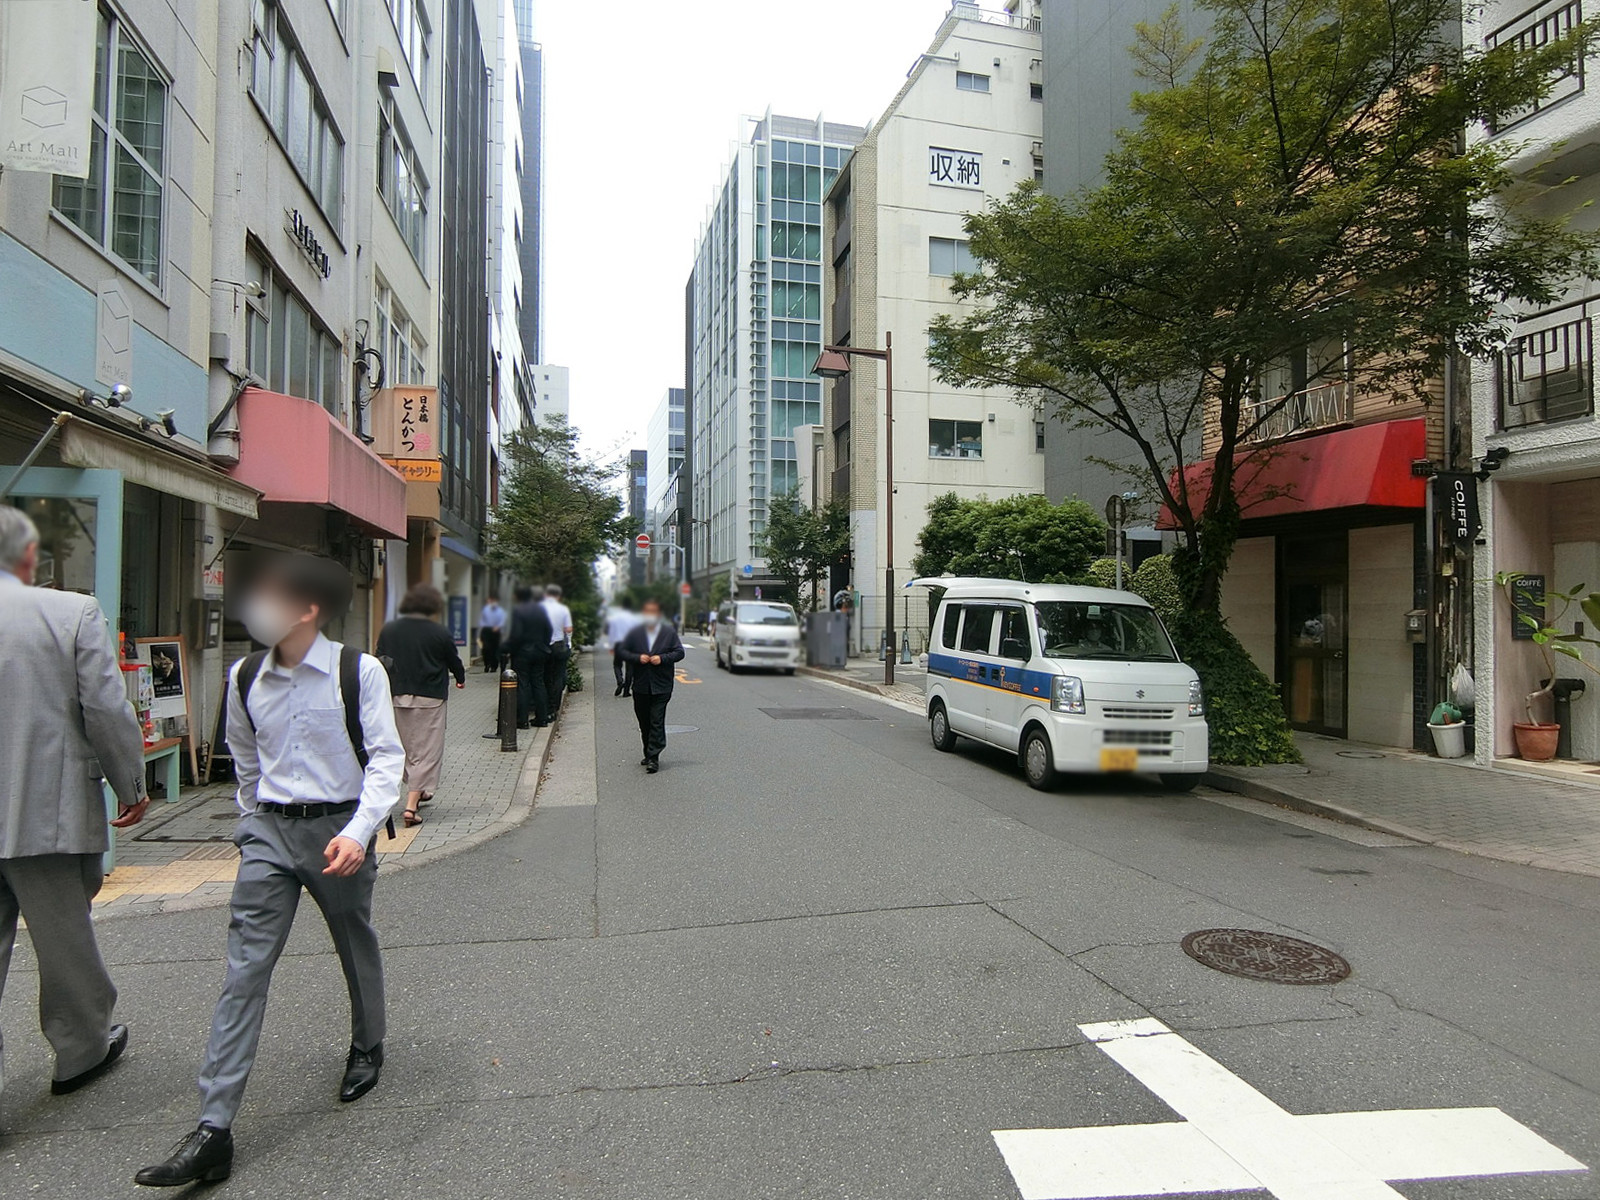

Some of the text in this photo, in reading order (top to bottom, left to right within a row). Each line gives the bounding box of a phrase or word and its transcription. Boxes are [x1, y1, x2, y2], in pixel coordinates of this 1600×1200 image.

[6, 140, 79, 159] Art Mall
[930, 152, 980, 185] 収納
[419, 395, 429, 423] 日本橋
[401, 397, 415, 452] とんかつ
